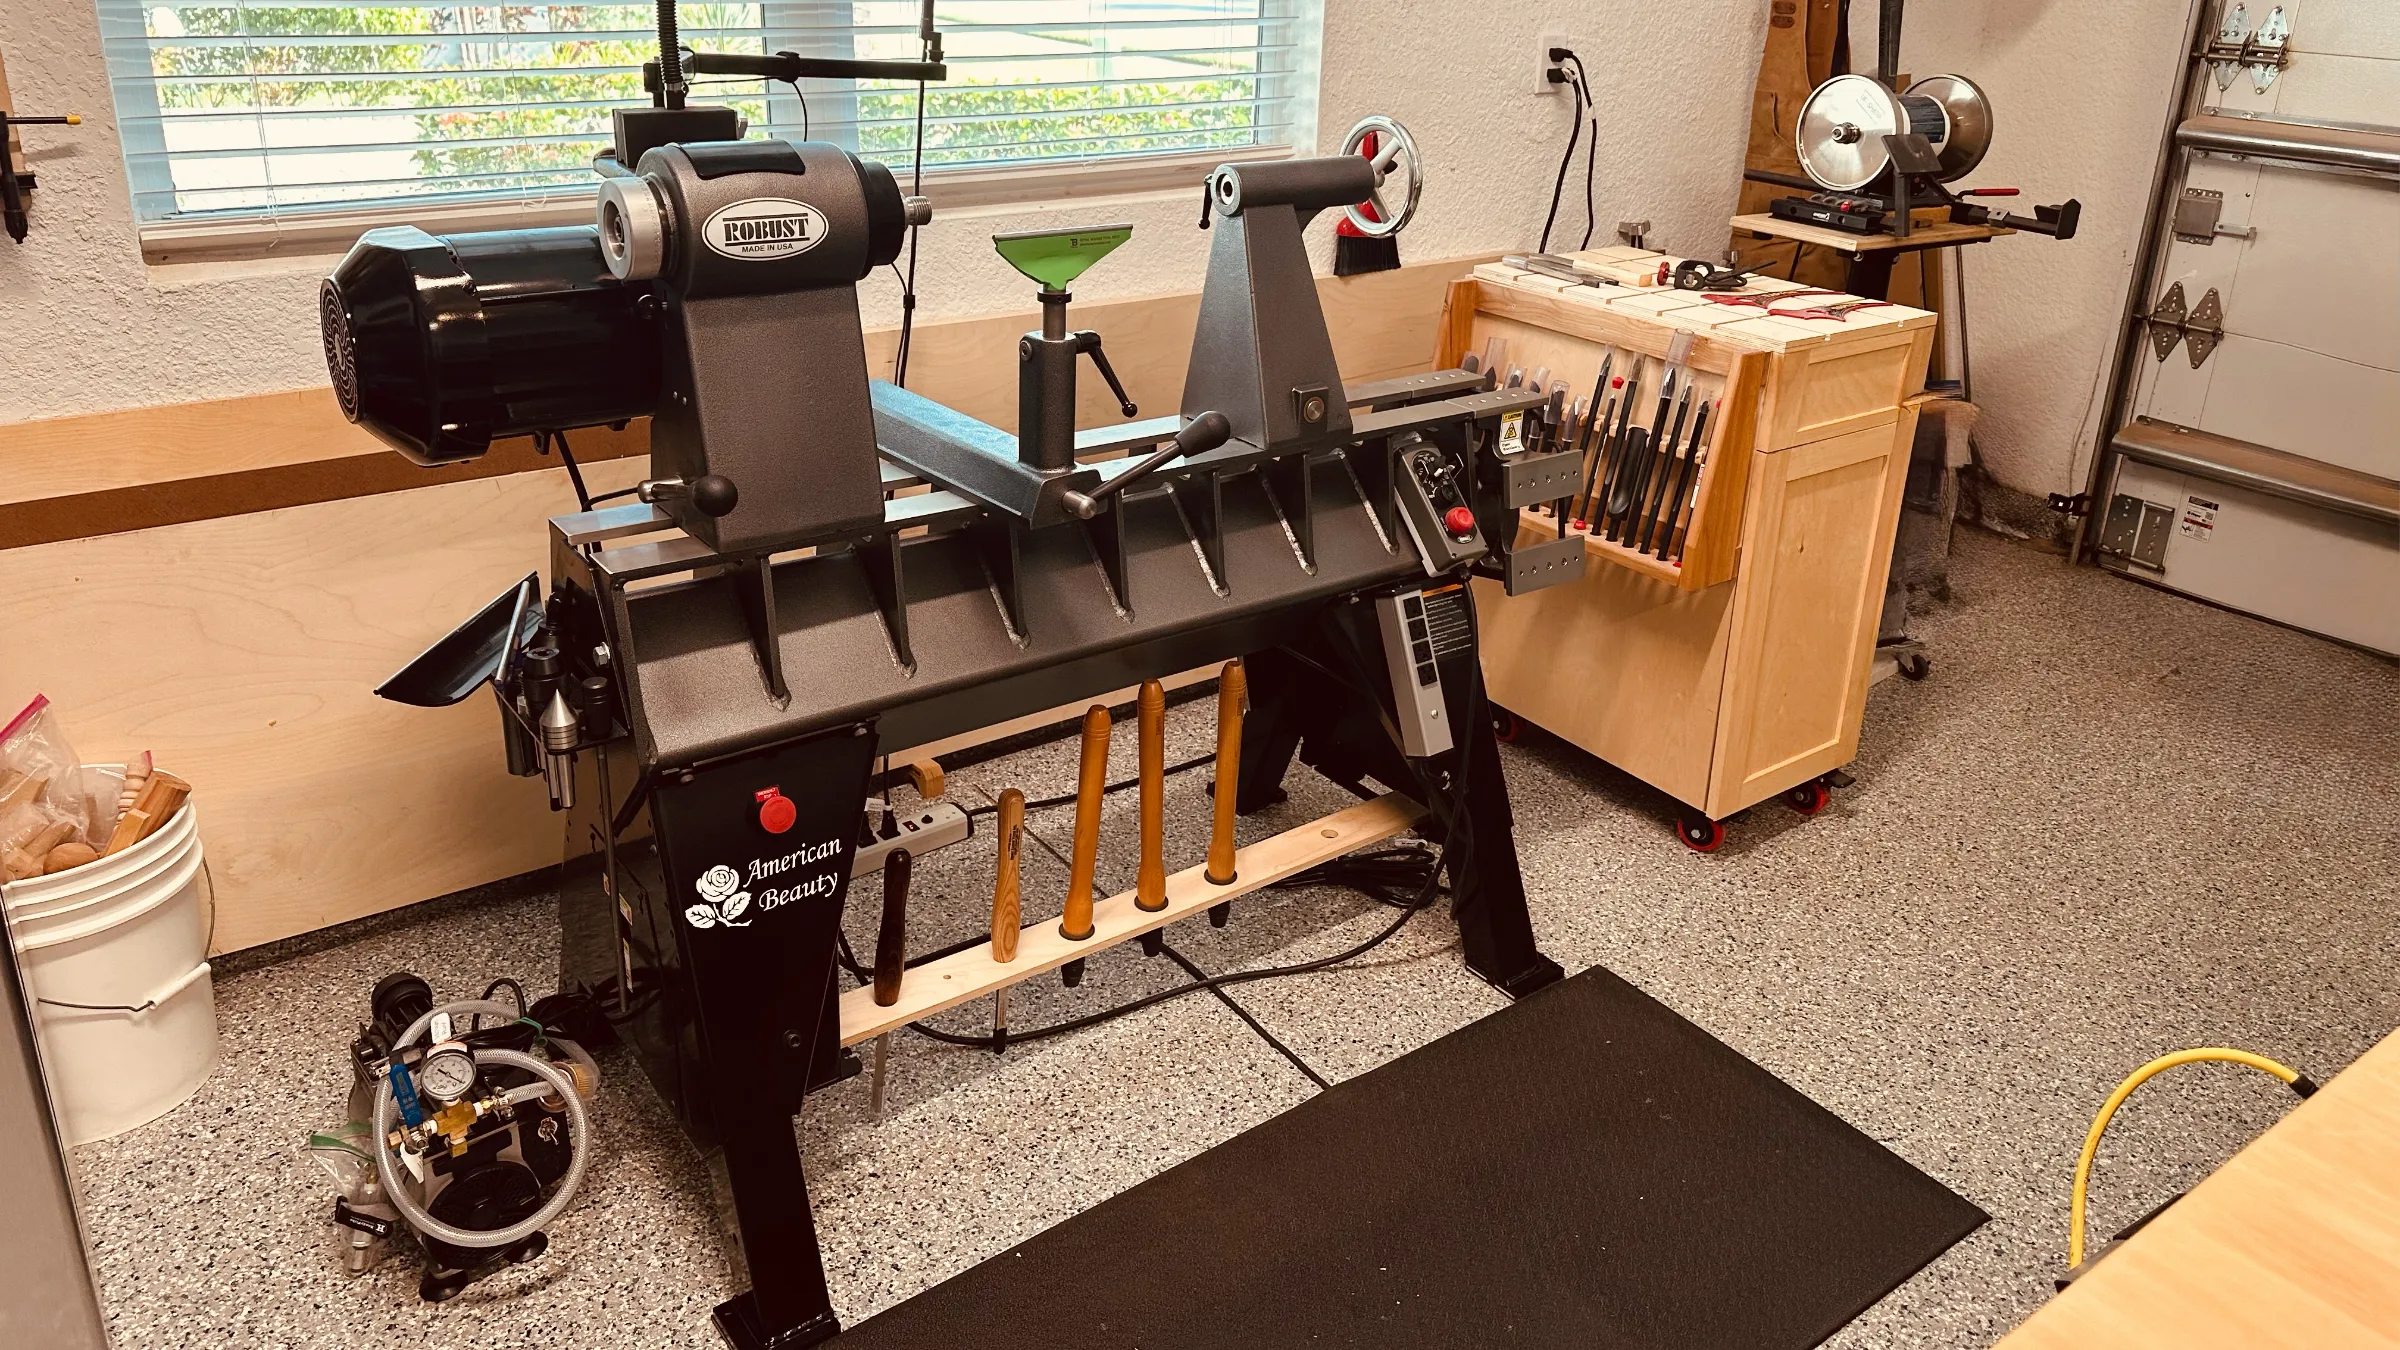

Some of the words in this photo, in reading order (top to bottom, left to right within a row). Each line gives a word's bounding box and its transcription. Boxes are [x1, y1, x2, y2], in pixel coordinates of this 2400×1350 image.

[724, 218, 809, 241] ROBUST
[741, 245, 765, 253] MADE
[777, 243, 794, 251] USA
[743, 838, 843, 888] American
[758, 872, 838, 911] Beauty
